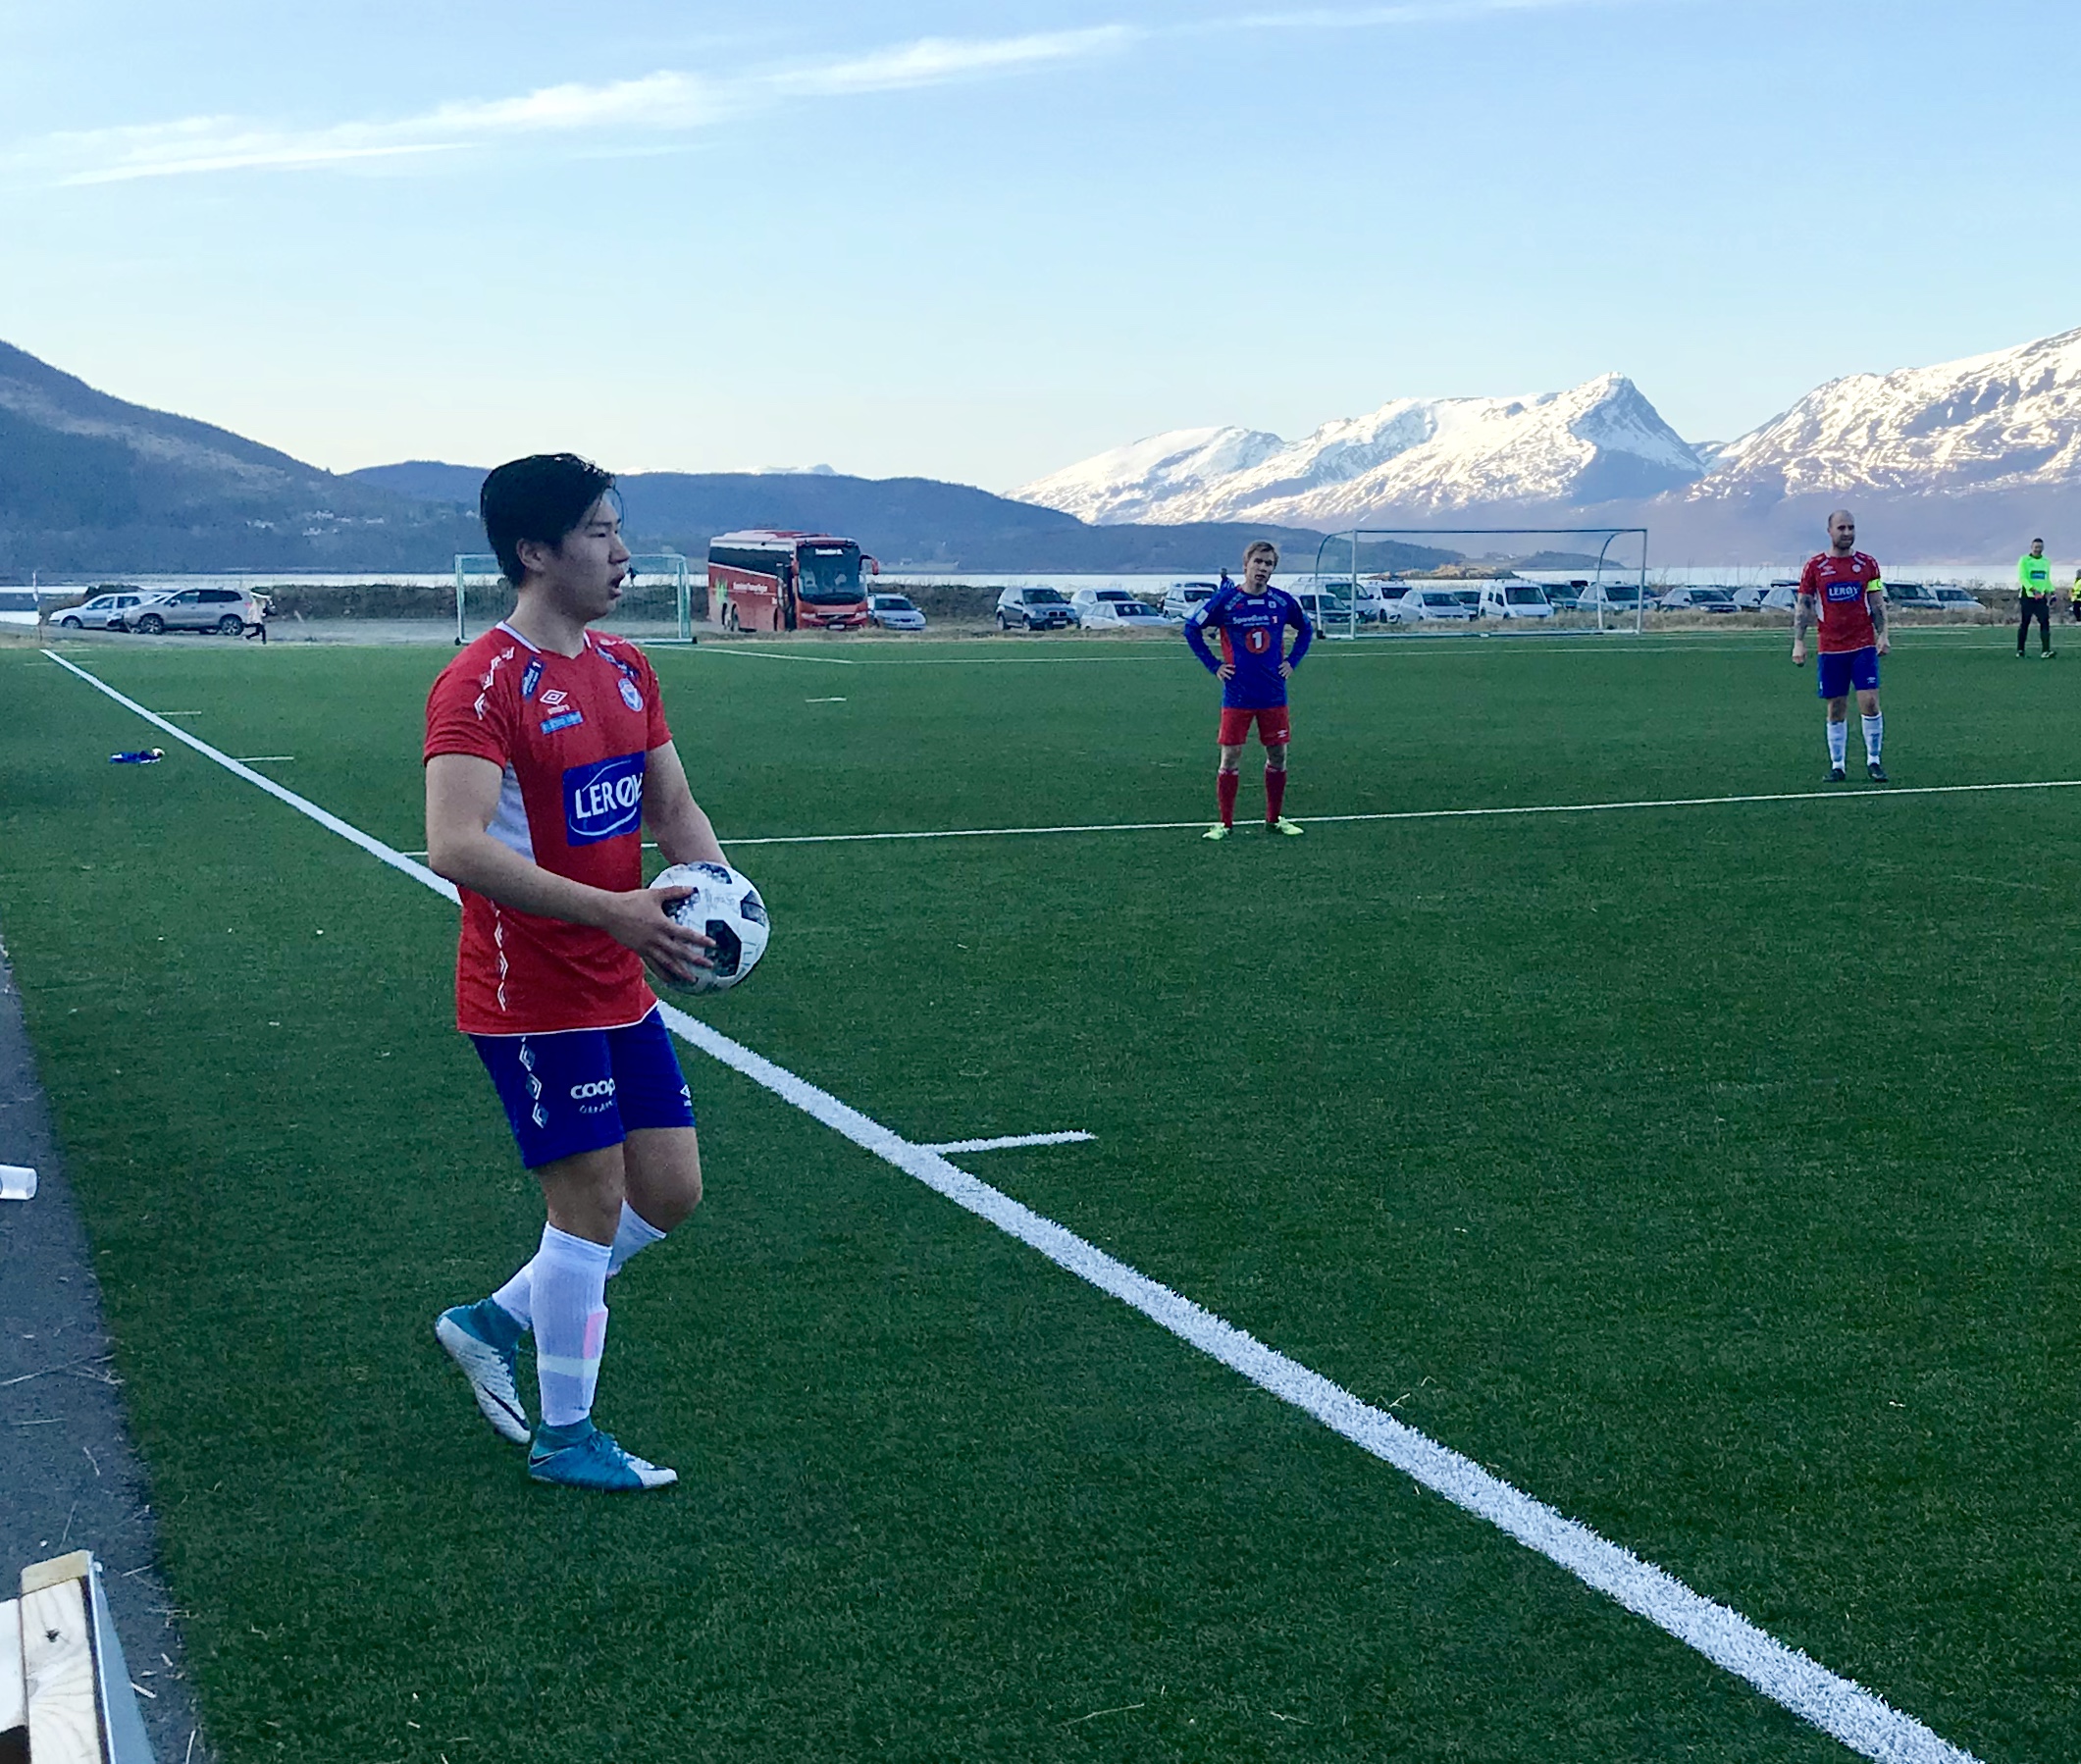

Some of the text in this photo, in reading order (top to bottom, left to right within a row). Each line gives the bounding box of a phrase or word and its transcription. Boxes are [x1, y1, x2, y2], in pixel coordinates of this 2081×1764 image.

[1272, 615, 1278, 624] 1
[1252, 631, 1263, 649] 1
[575, 769, 643, 819] LERØY
